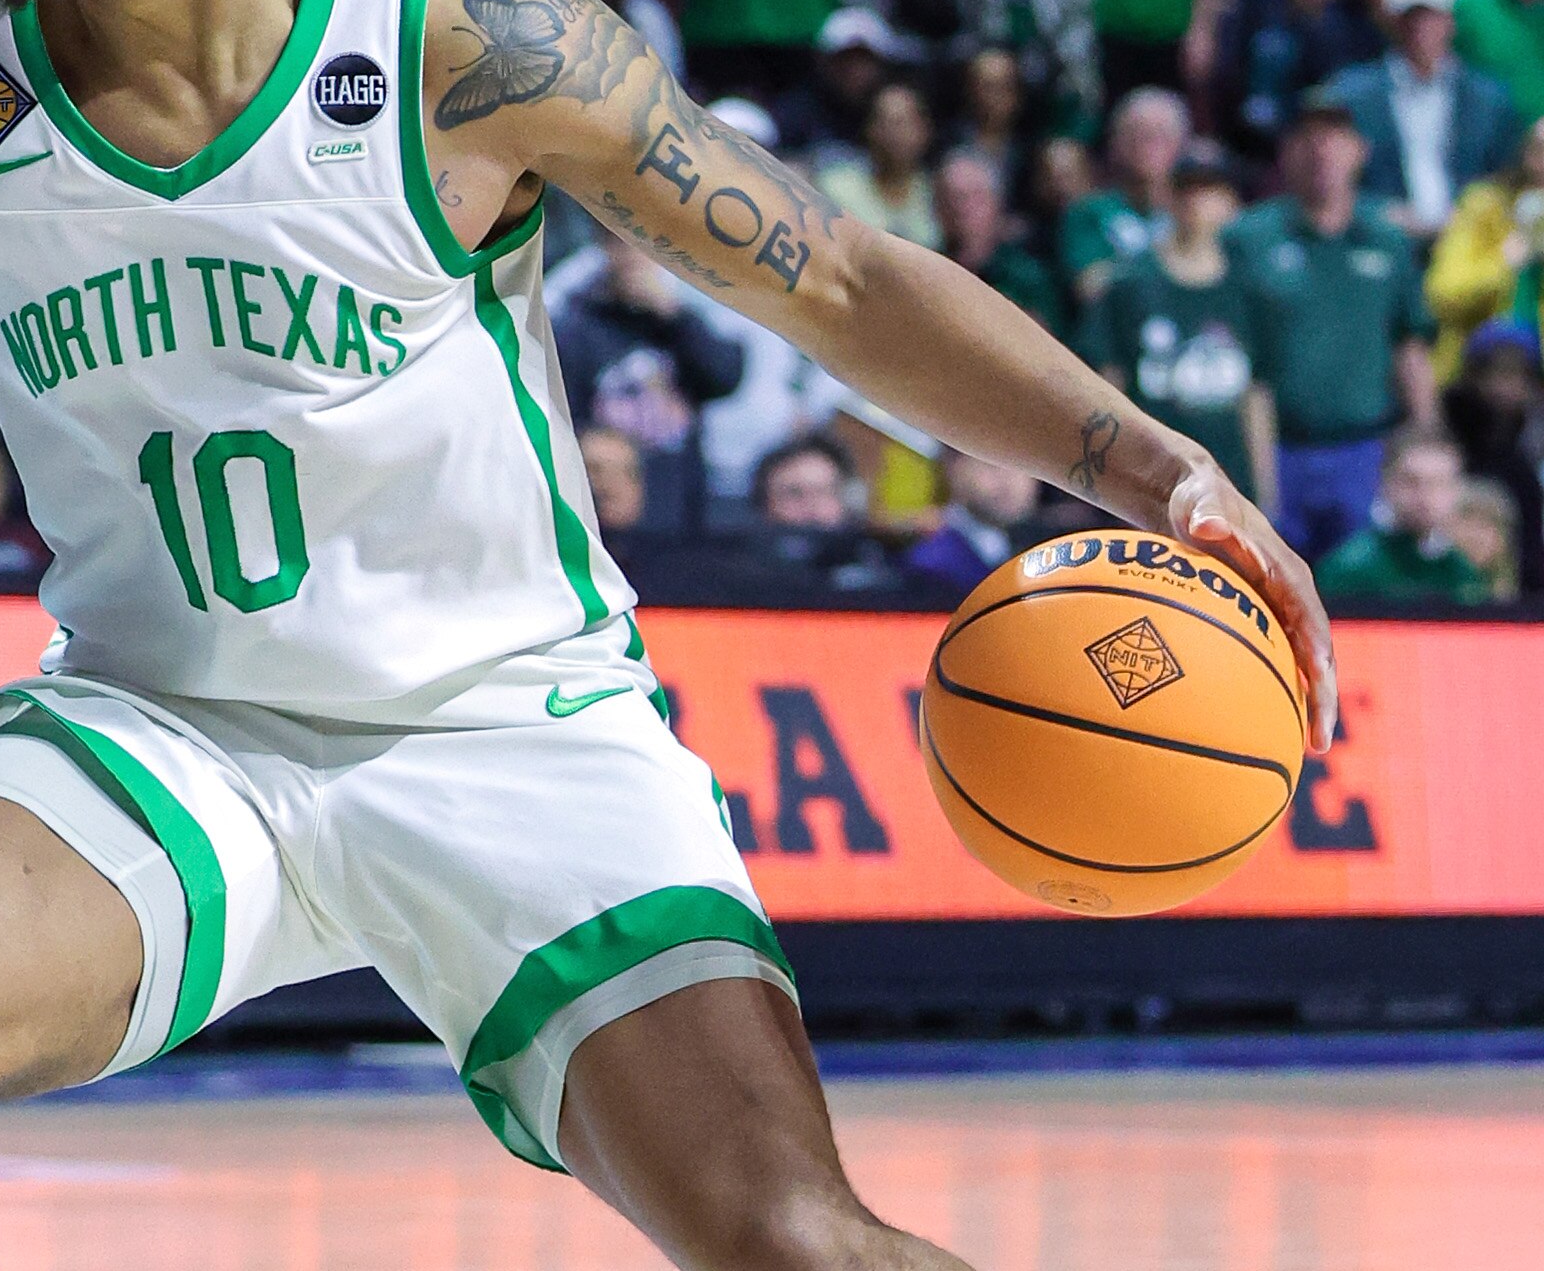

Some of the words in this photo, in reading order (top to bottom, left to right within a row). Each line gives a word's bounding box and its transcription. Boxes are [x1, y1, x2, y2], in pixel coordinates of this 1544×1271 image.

[318, 74, 385, 105] HAGG
[314, 142, 363, 158] C-USA
[0, 256, 177, 399] NORTH
[185, 256, 407, 378] TEXAS
[138, 429, 310, 614] 10
[1020, 537, 1276, 648] Wilson
[1118, 568, 1156, 580] EVO
[1162, 576, 1198, 594] NXT
[1108, 646, 1161, 673] NIT
